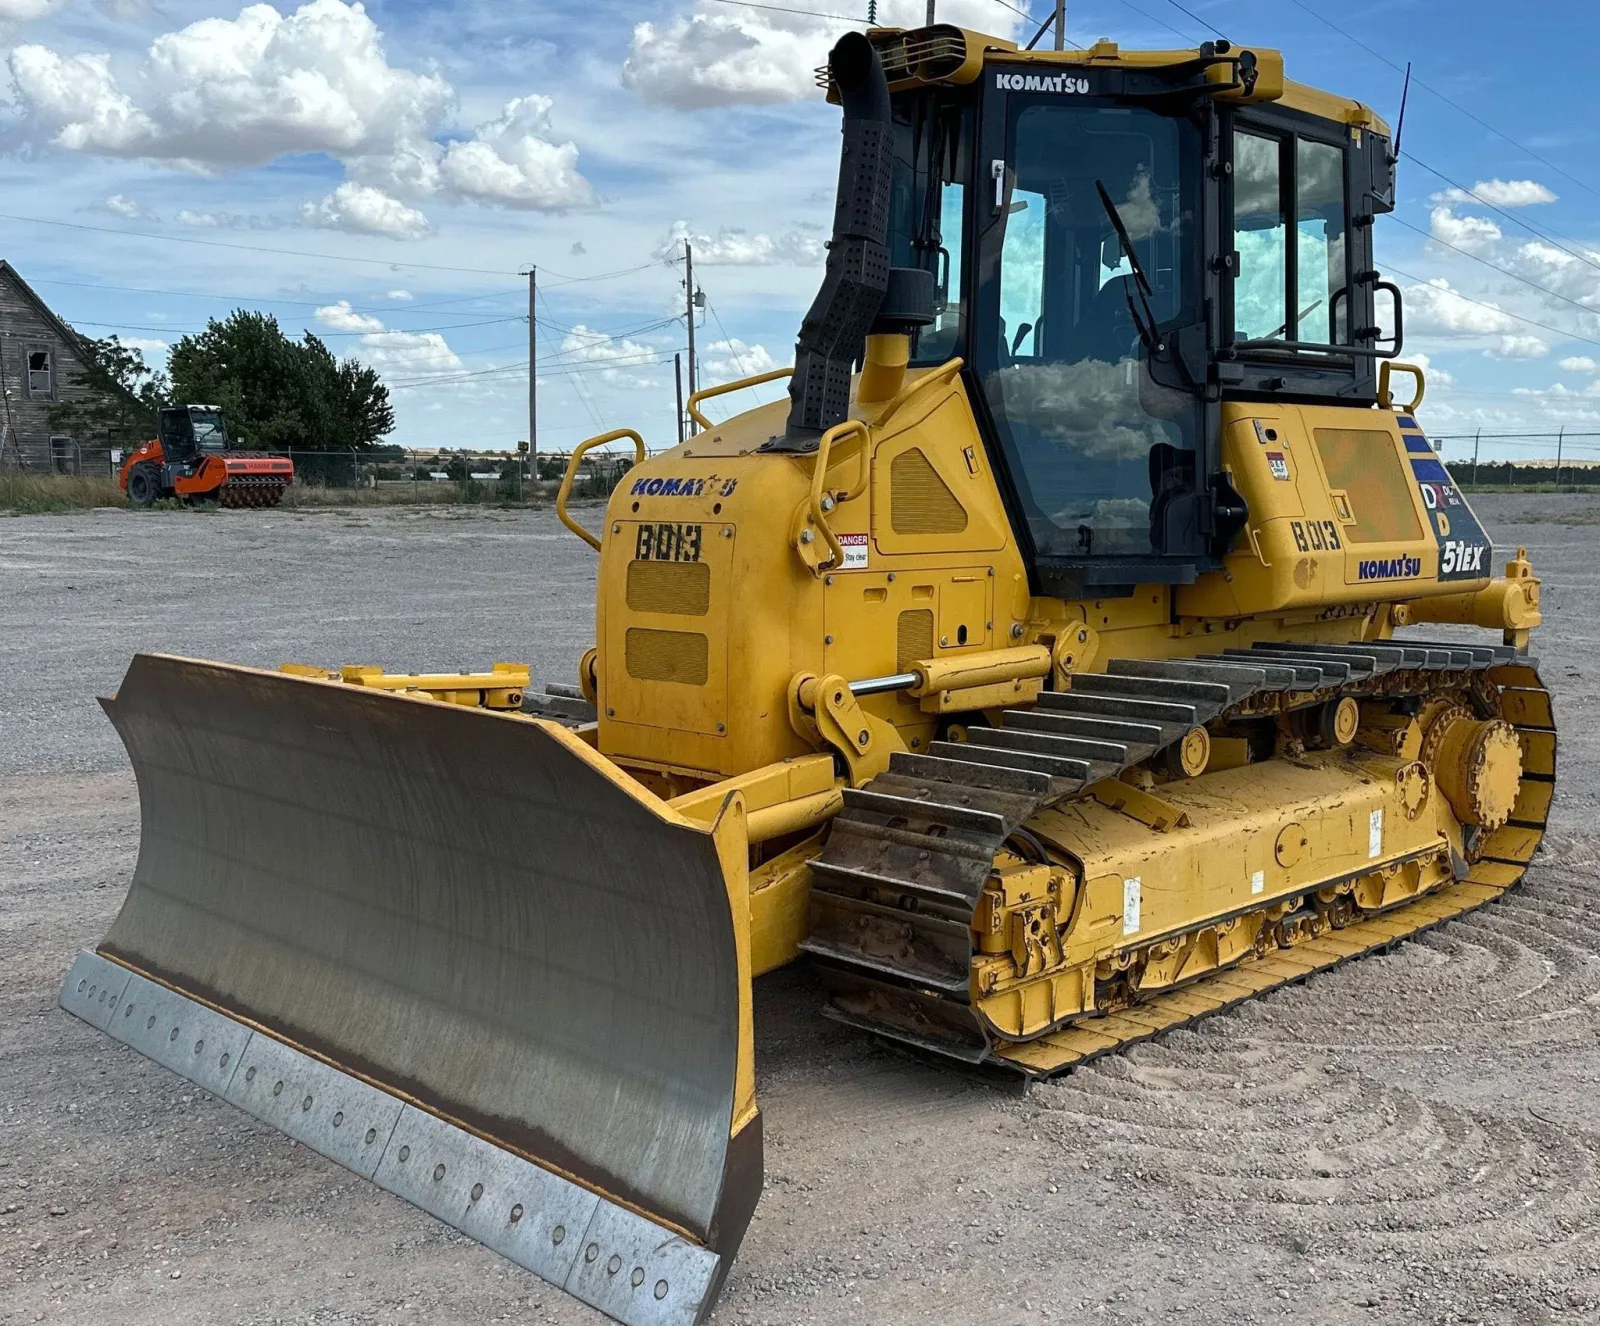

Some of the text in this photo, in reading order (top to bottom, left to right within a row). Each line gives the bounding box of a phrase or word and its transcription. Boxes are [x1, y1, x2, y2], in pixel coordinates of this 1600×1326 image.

[996, 73, 1090, 94] KOMATSU
[630, 475, 738, 497] KOMATU
[838, 535, 868, 545] DANGER
[1358, 553, 1421, 580] KOMATSU
[1441, 540, 1484, 574] 51EX
